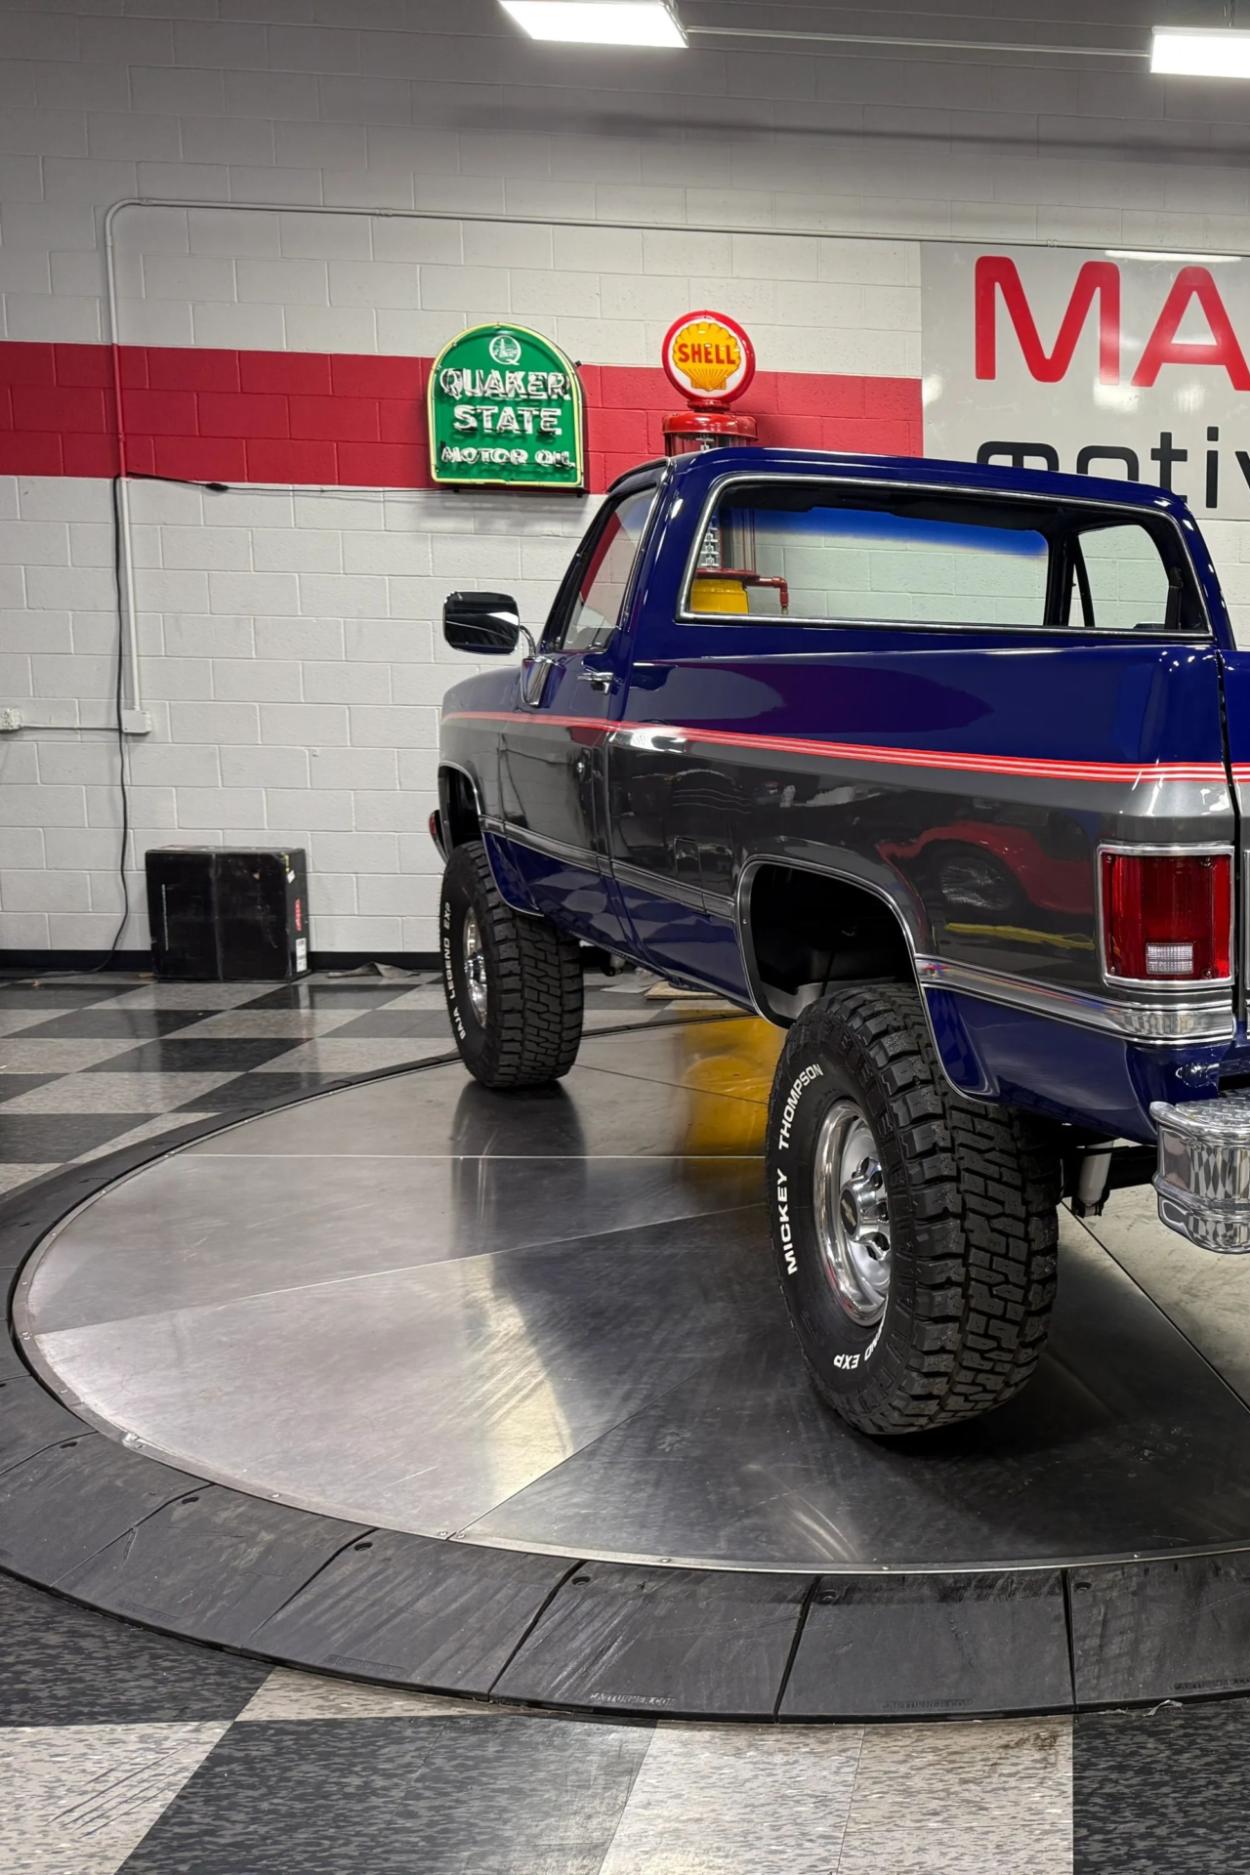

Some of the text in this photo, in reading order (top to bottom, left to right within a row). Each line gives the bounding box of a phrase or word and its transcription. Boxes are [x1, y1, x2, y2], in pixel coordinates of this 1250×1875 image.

[677, 342, 737, 366] SHELL
[440, 368, 571, 400] QUAKER
[453, 404, 562, 435] STATE
[441, 446, 576, 467] MOTOR OIL
[776, 1063, 824, 1275] MICKEY THOMPSON
[833, 1353, 861, 1370] EXP
